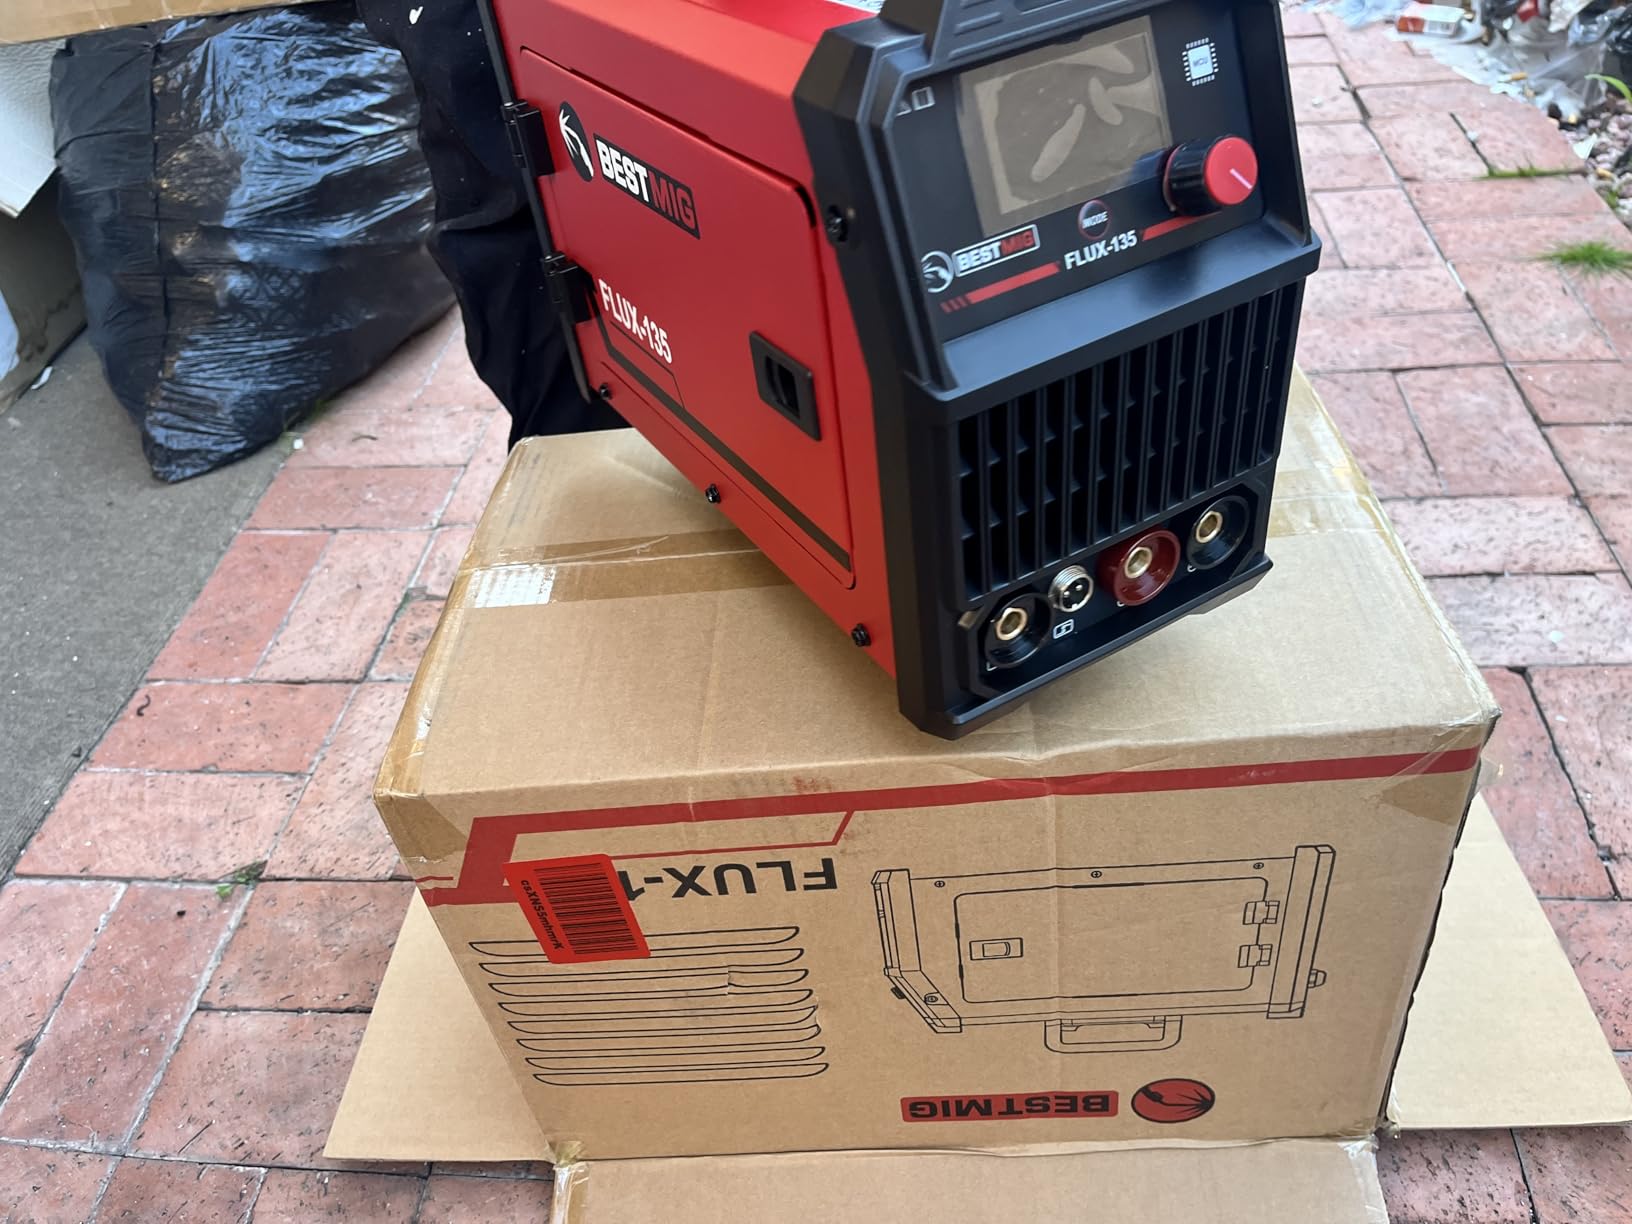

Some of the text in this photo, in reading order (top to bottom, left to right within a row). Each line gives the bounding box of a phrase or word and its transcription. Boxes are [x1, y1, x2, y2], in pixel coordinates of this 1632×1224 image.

[596, 139, 695, 230] BESTMIG
[957, 230, 1035, 271] BESTMIG
[1064, 230, 1138, 270] FLUX-135
[598, 279, 672, 364] FLUX-135
[620, 858, 837, 902] FLUX-1
[908, 1094, 1111, 1121] BESTMIG
